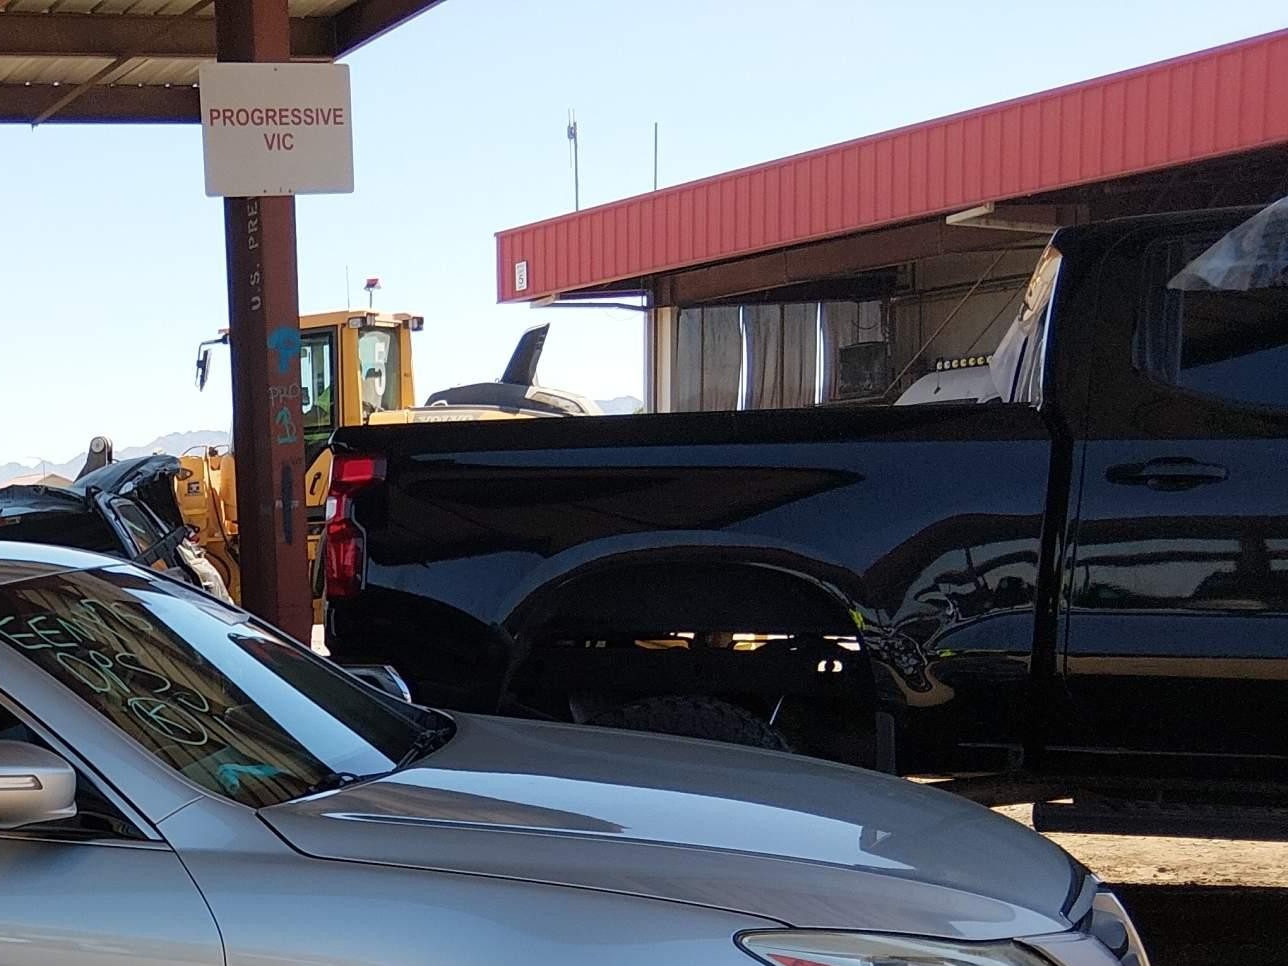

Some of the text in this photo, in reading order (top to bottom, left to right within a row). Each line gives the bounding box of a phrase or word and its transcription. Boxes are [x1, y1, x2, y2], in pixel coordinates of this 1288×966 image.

[209, 107, 345, 127] PROGRESSIVE
[263, 132, 294, 151] VIC
[246, 195, 261, 251] PRE
